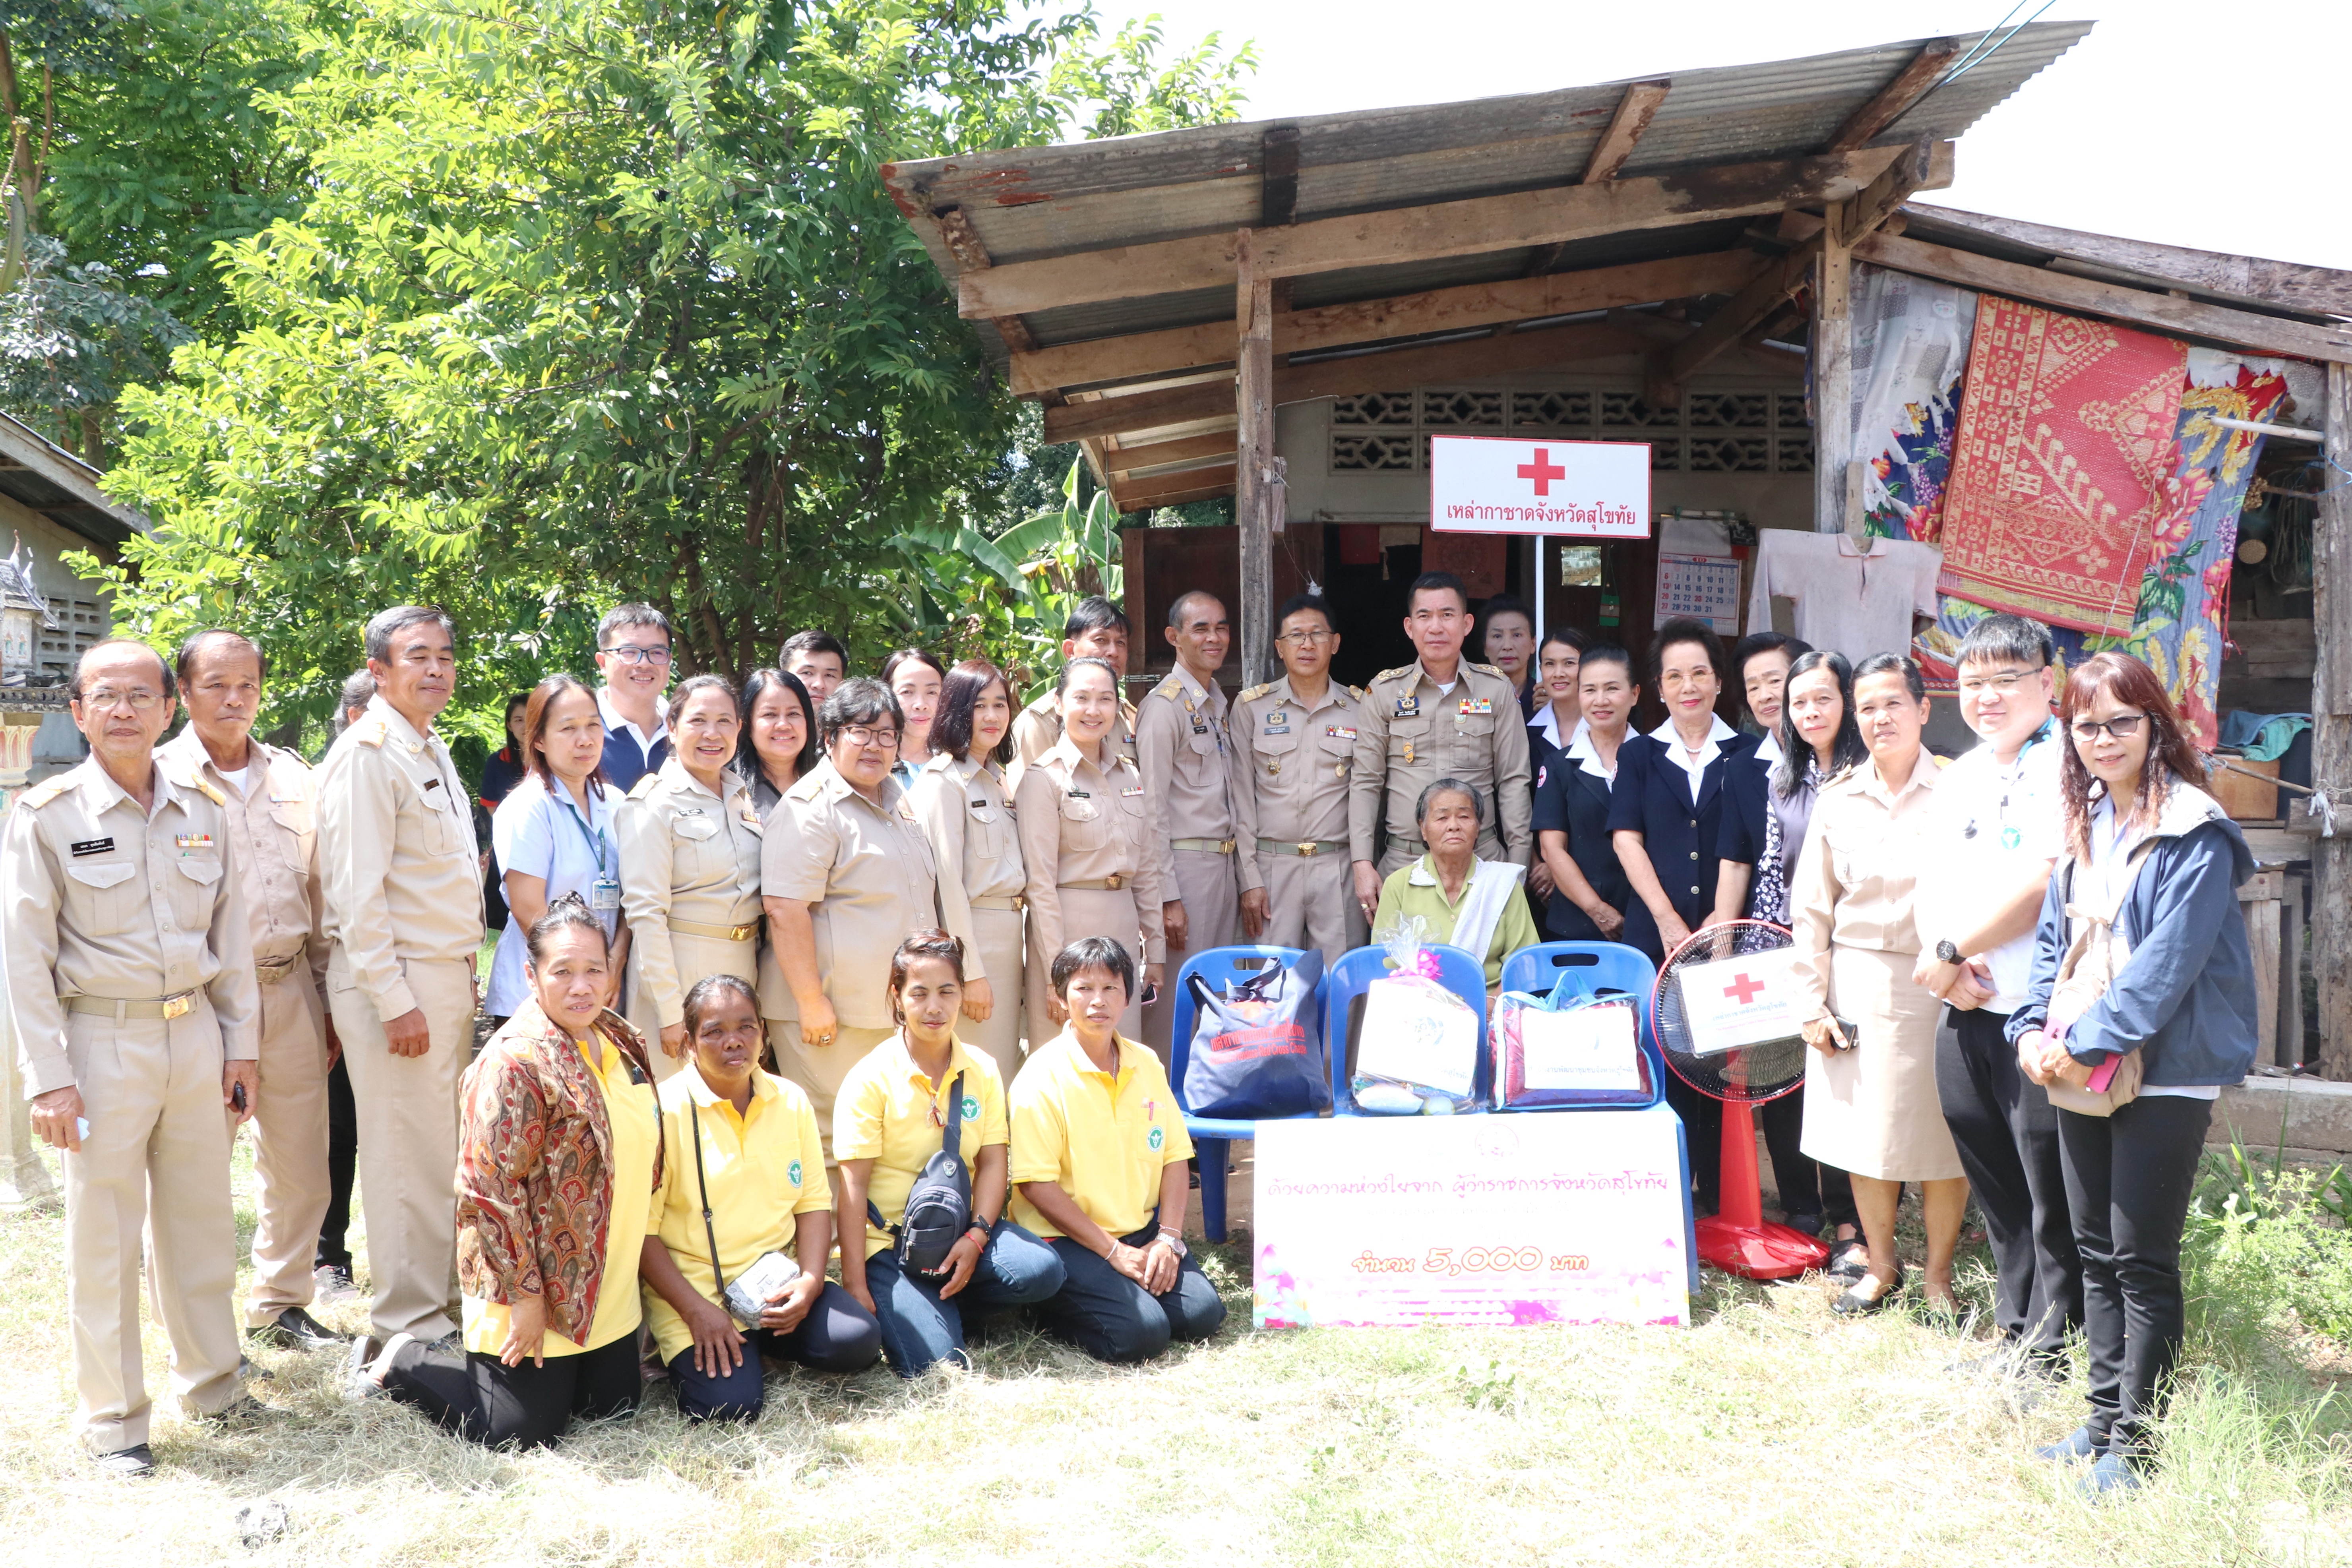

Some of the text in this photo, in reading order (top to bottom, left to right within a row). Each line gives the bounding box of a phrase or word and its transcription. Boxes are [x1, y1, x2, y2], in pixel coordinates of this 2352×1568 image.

[1447, 500, 1636, 531] เหล่ากาชาดจังหวัดสุโขทัย
[1258, 1045, 1271, 1057] Red
[1271, 1043, 1289, 1055] Cross
[1268, 1170, 1667, 1198] ด้วยความห่วงใยจาก ผู้ว่าราชการจังหวัดสุโขทัย
[1351, 1246, 1589, 1276] จำนวน 5,000 บาท
